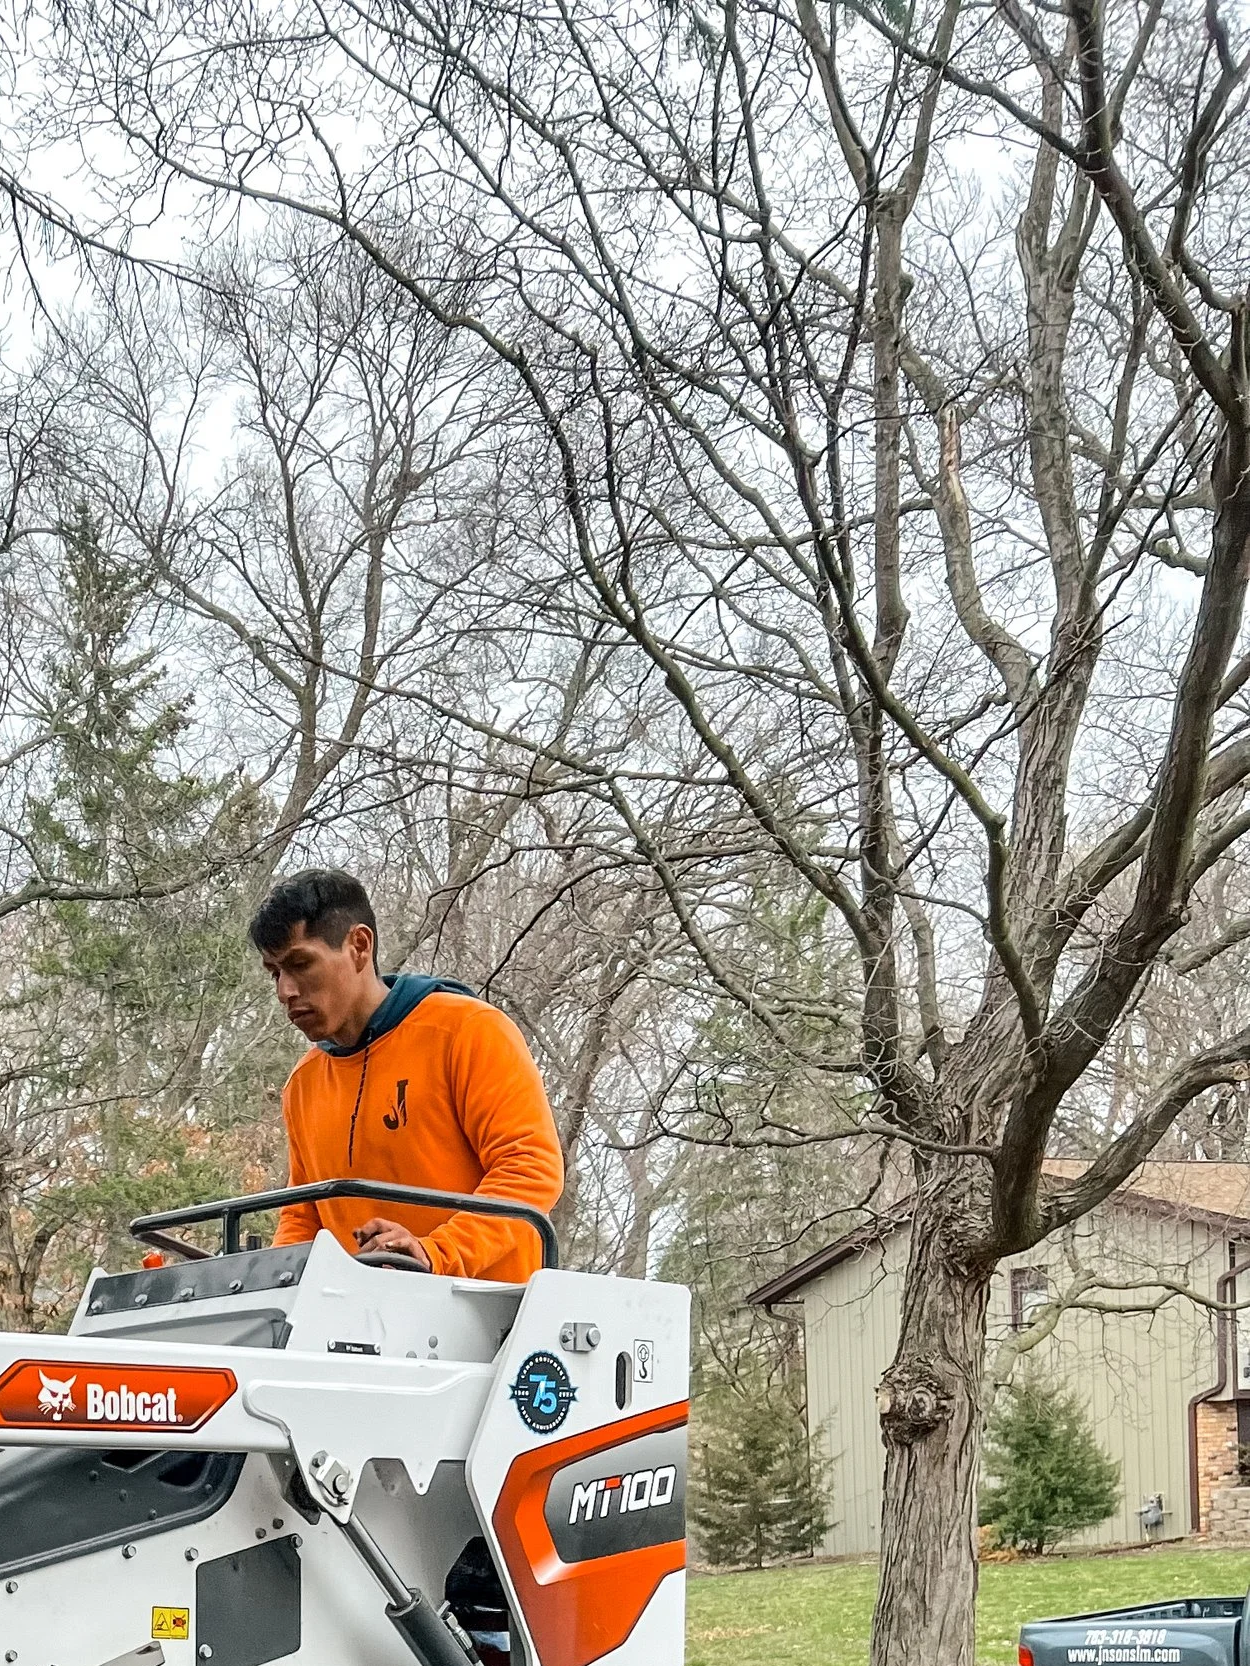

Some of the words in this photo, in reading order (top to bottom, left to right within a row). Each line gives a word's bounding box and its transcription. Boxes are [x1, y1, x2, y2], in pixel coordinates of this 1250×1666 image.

[86, 1383, 177, 1423] Bobcat
[529, 1374, 557, 1414] 75
[569, 1465, 676, 1525] MT100
